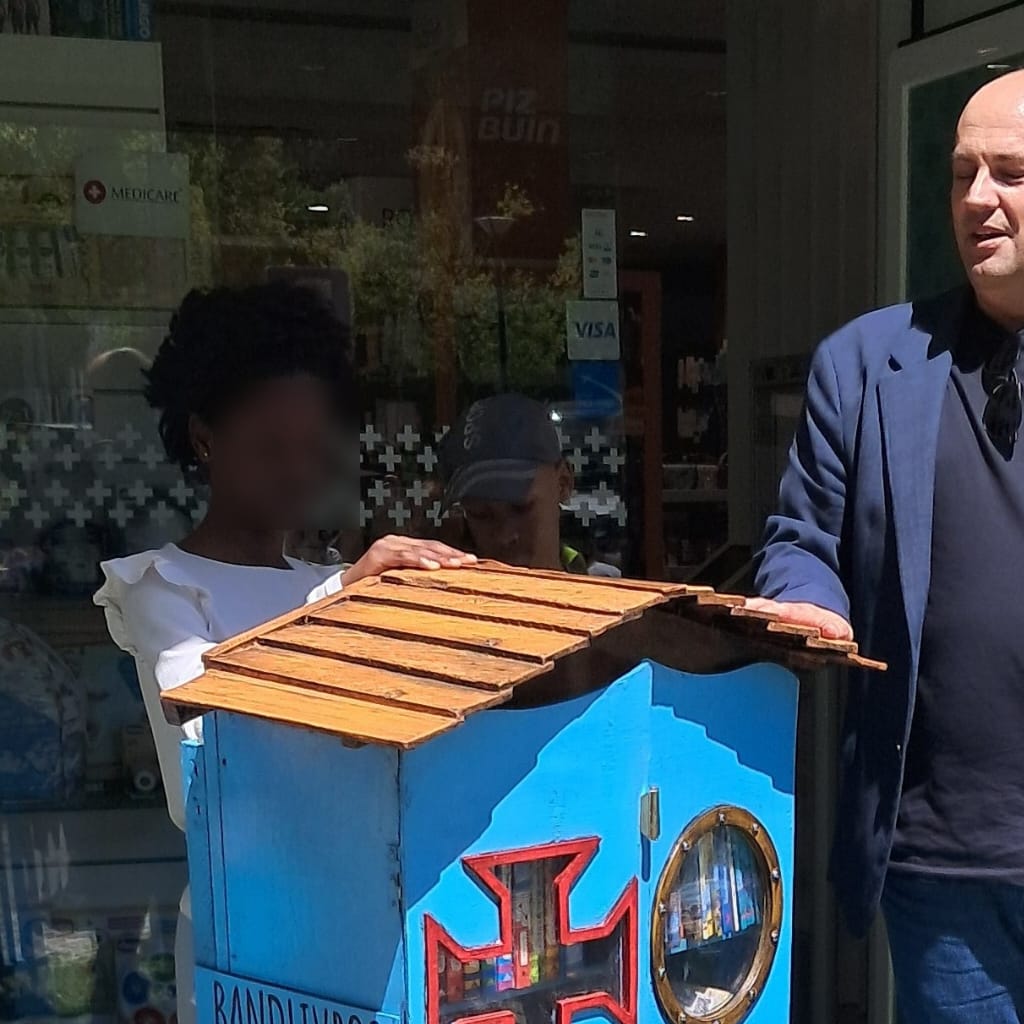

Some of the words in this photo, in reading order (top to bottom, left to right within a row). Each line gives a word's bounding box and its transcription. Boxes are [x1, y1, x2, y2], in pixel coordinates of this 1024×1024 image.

[482, 88, 537, 115] PIZ
[478, 116, 561, 145] BUIN
[111, 186, 180, 204] MEDICARE
[575, 321, 616, 339] VISA
